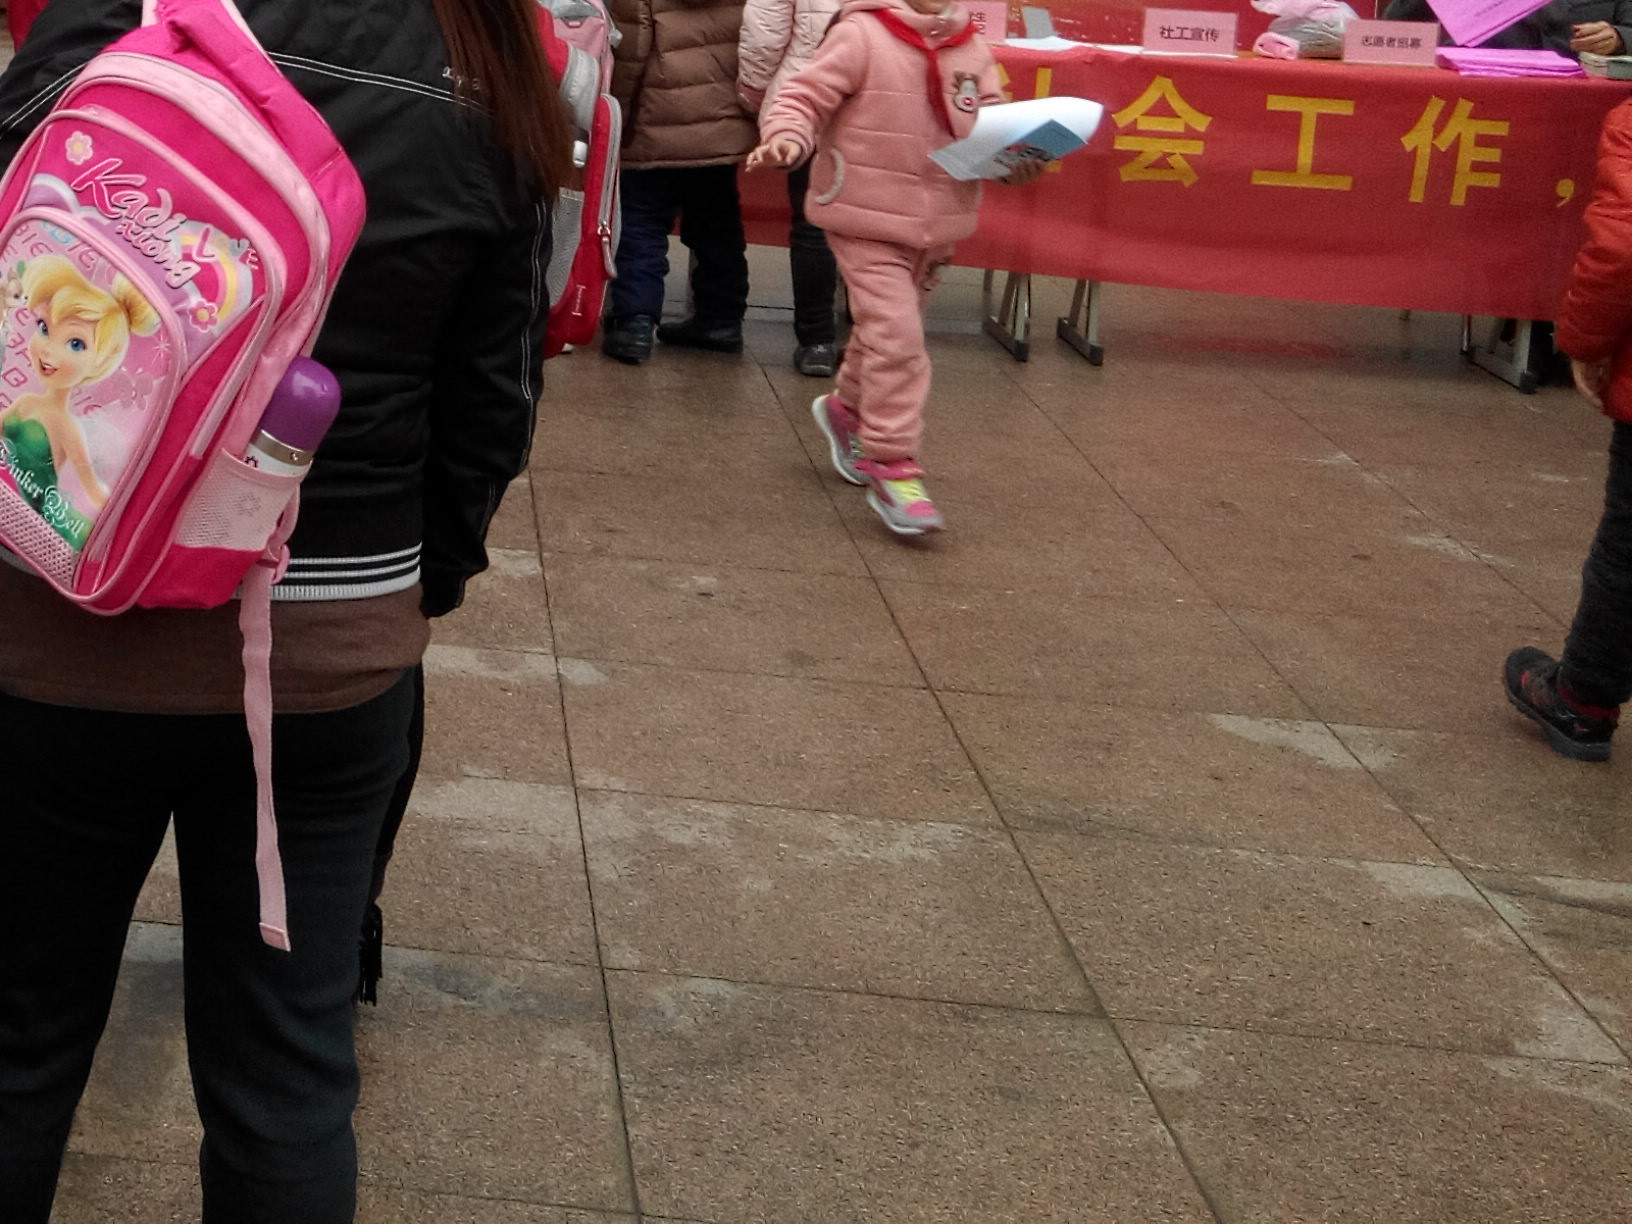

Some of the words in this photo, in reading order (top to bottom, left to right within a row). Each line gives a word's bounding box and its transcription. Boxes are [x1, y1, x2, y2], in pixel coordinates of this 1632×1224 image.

[1159, 25, 1219, 43] 社工宣传
[71, 158, 187, 242] Kadi
[43, 485, 84, 538] Bell
